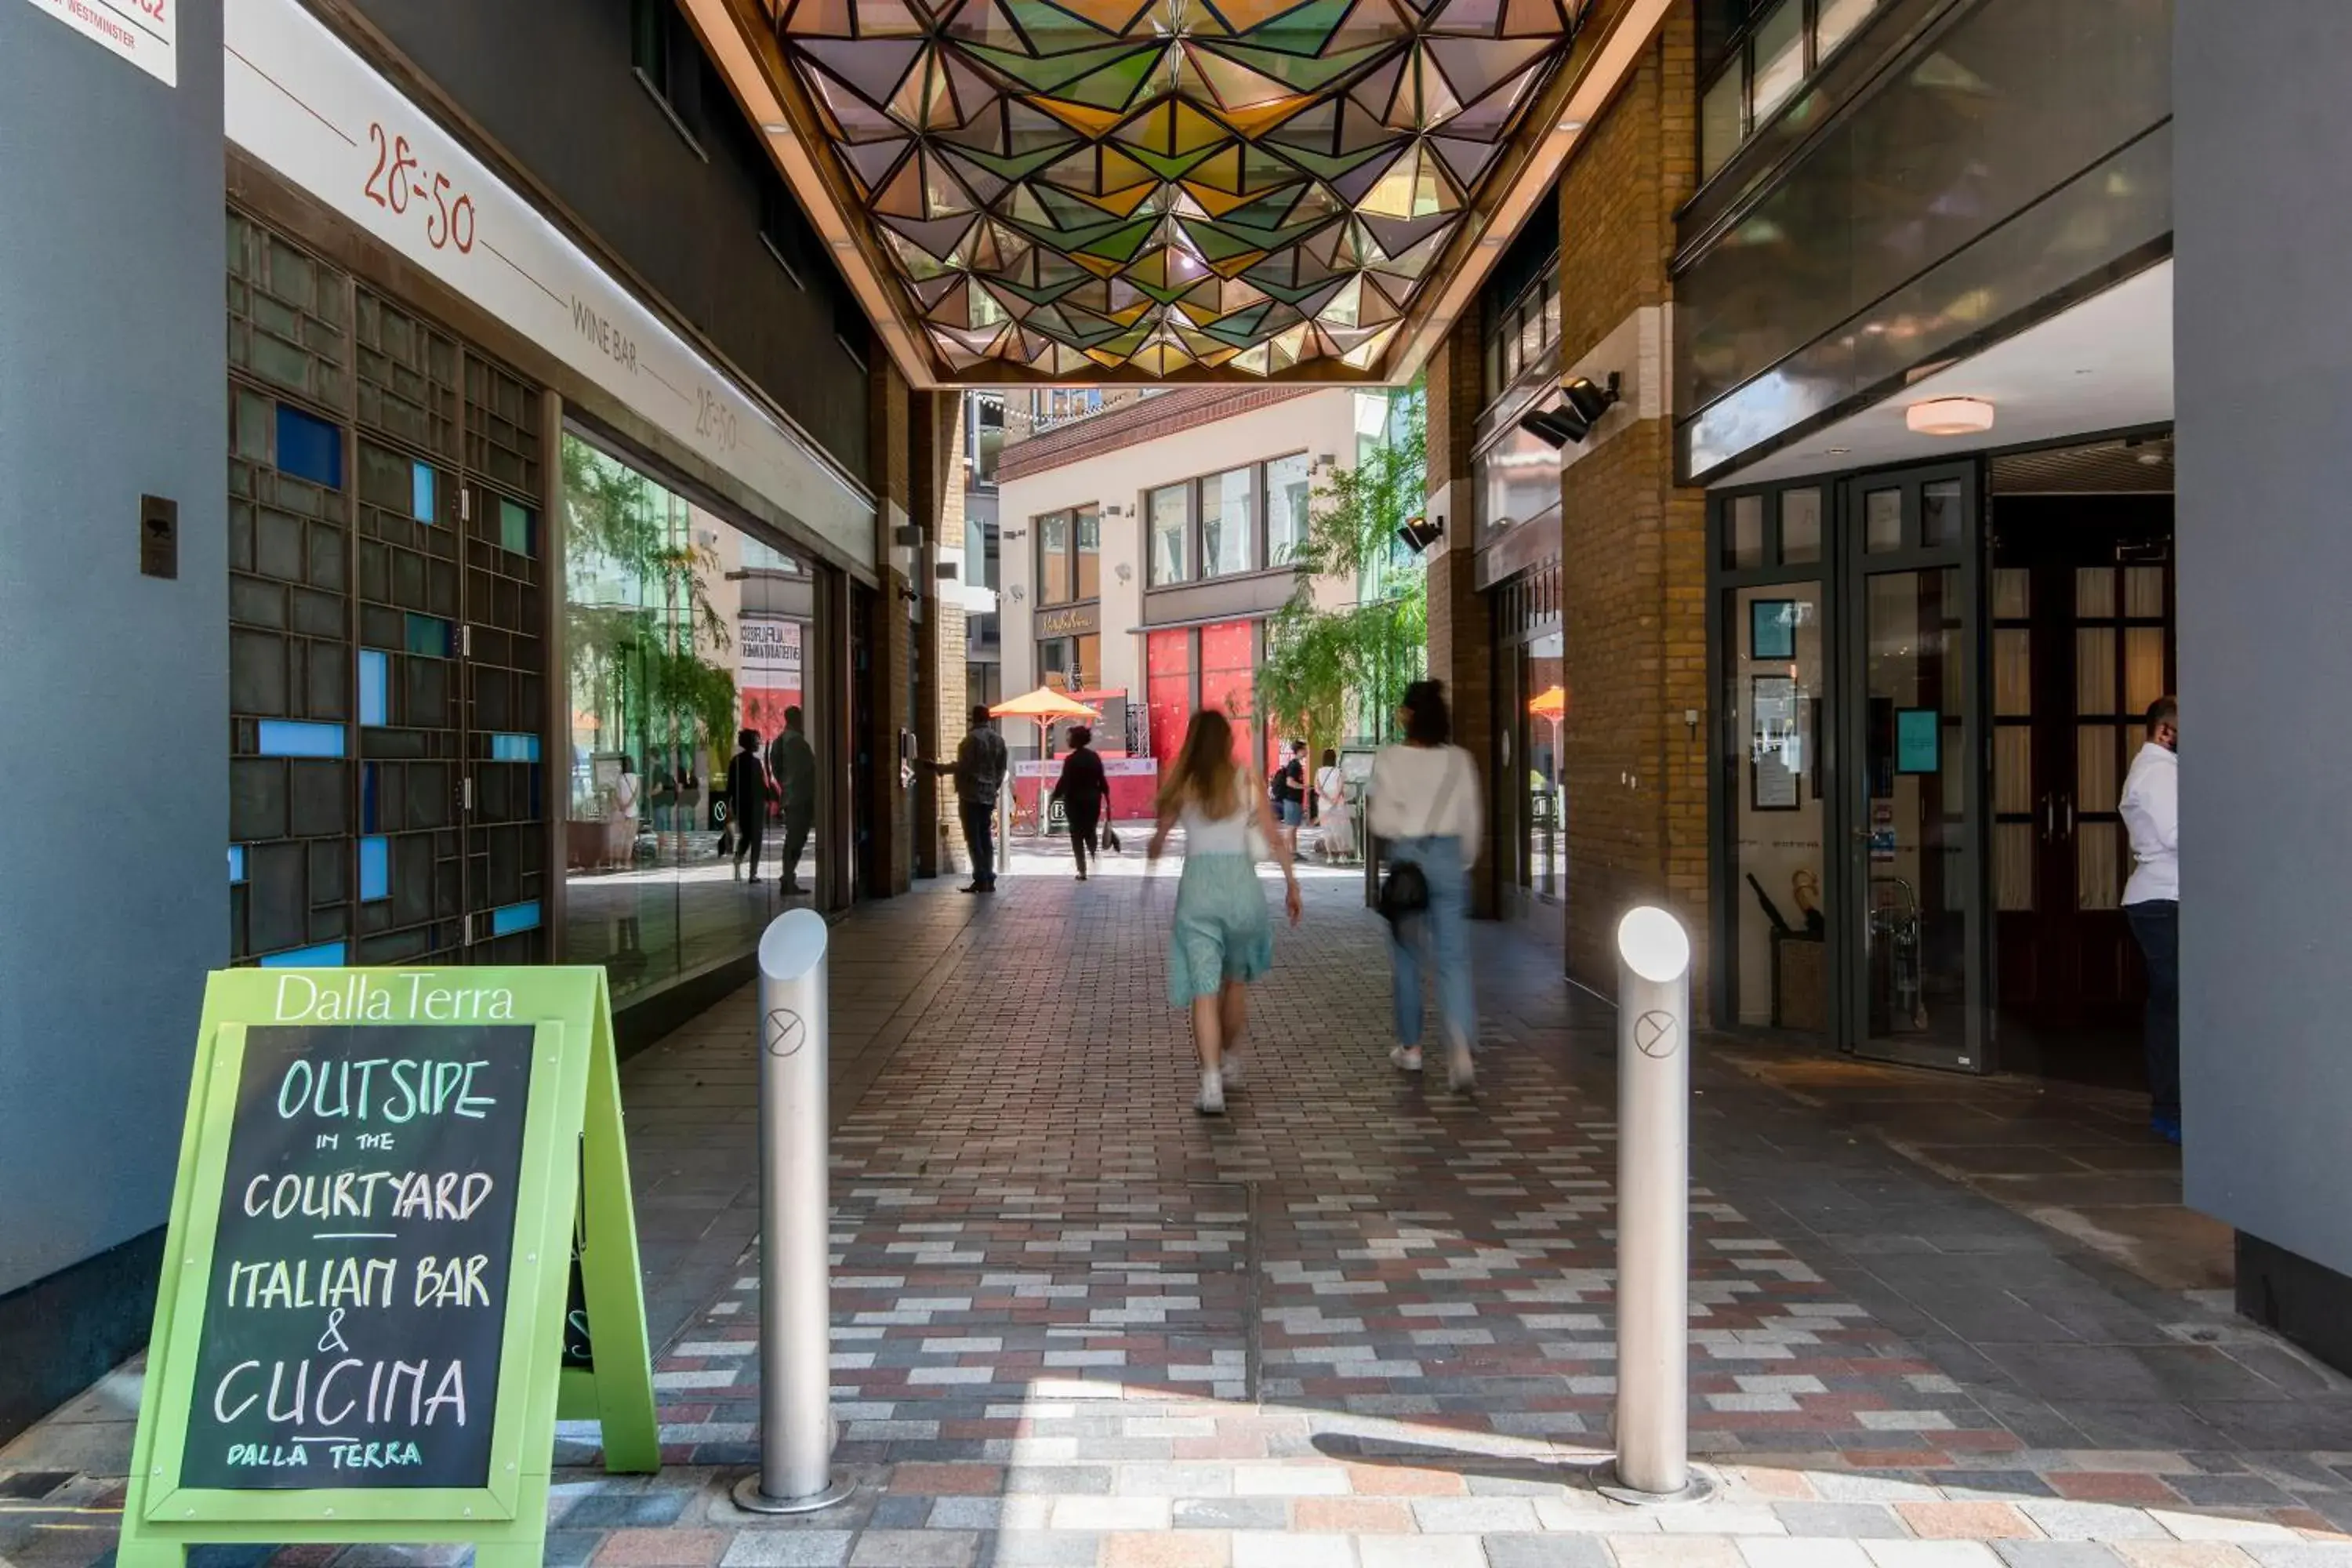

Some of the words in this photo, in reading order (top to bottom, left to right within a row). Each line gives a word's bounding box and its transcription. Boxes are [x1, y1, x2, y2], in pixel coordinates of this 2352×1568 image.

[67, 0, 136, 49] WESTMINSTER
[572, 294, 610, 355] WINE
[612, 328, 638, 376] BAR
[274, 973, 392, 1021] Dalla
[397, 973, 515, 1020] Terra
[278, 1058, 497, 1123] OUTSIDE
[316, 1133, 339, 1151] IN
[356, 1131, 396, 1152] THE
[243, 1171, 493, 1221] COURTYARD
[227, 1257, 397, 1308] ITALIAN
[413, 1254, 491, 1307] BAR
[317, 1307, 350, 1353] &
[213, 1358, 466, 1428] CUCINA
[226, 1441, 307, 1467] DALLA
[328, 1443, 423, 1469] TERRA
